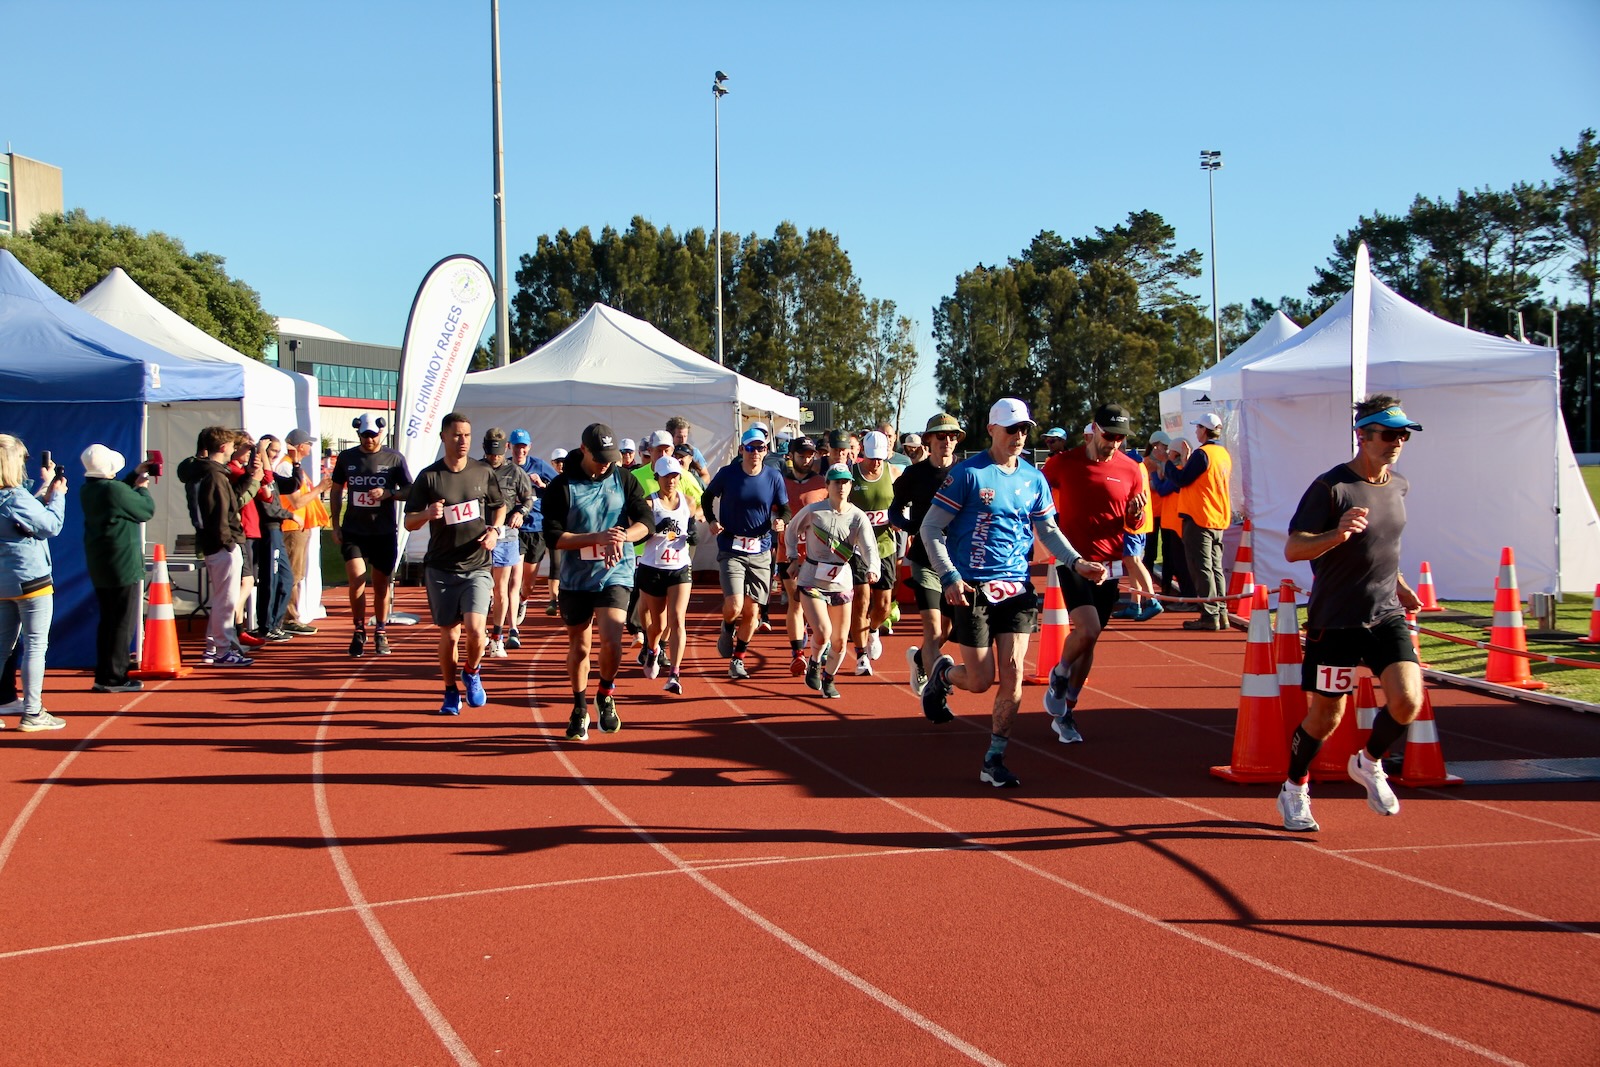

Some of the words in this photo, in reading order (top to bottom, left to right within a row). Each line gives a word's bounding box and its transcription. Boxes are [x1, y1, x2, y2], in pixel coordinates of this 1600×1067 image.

[406, 414, 422, 439] SRI
[415, 351, 444, 413] CHINMOY
[437, 305, 462, 351] RACES
[424, 322, 470, 434] nz.srichinmoyraces.org
[348, 475, 387, 486] serco
[451, 503, 473, 521] 14
[866, 511, 885, 525] 22
[740, 537, 756, 551] 12
[660, 549, 681, 563] 44
[827, 566, 838, 579] 4
[989, 580, 1017, 600] 50
[1320, 667, 1352, 690] 15
